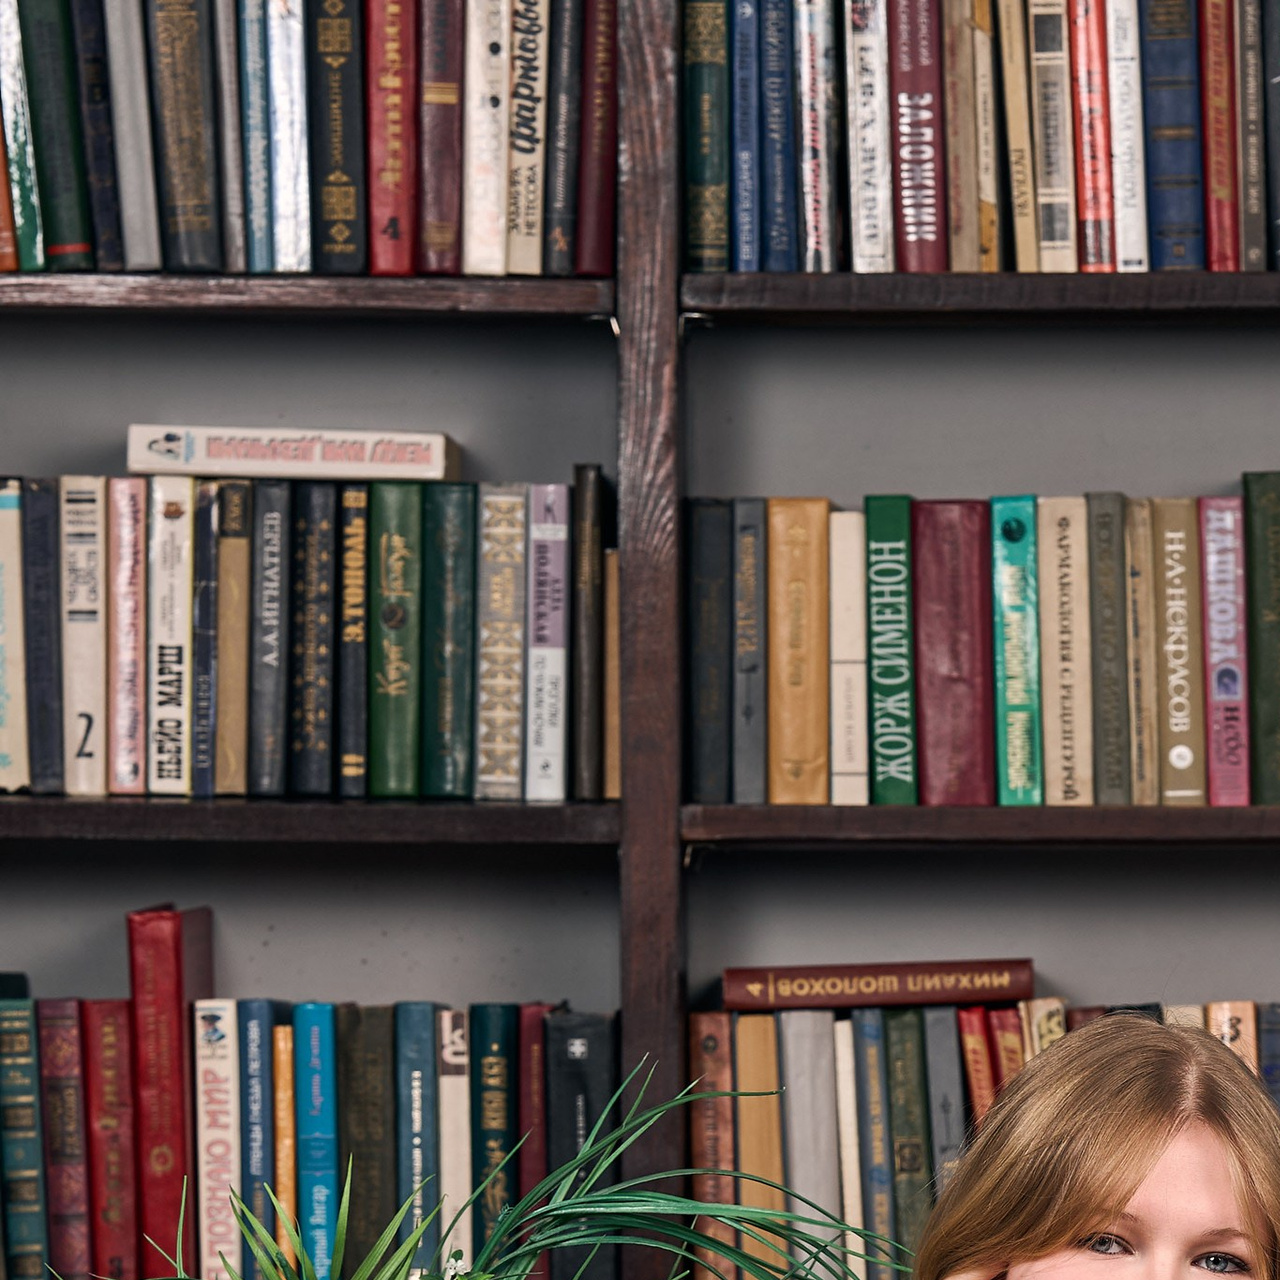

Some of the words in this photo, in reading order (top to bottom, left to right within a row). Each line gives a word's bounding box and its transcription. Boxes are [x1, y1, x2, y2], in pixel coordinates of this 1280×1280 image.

[341, 516, 366, 643] Э.ТОПОЛЬ
[870, 539, 911, 685] СИМЕНОН
[1205, 509, 1239, 664] ДАШКОВА
[157, 644, 184, 707] МАРШ
[152, 718, 183, 780] НЬЕЙО
[873, 690, 914, 783] ЖОРЖ
[777, 975, 900, 998] ШОЛОХОВ
[907, 970, 1012, 994] МИХАИЛ
[201, 1067, 232, 1132] МИР
[205, 1138, 236, 1257] ПОЗНАЮ
